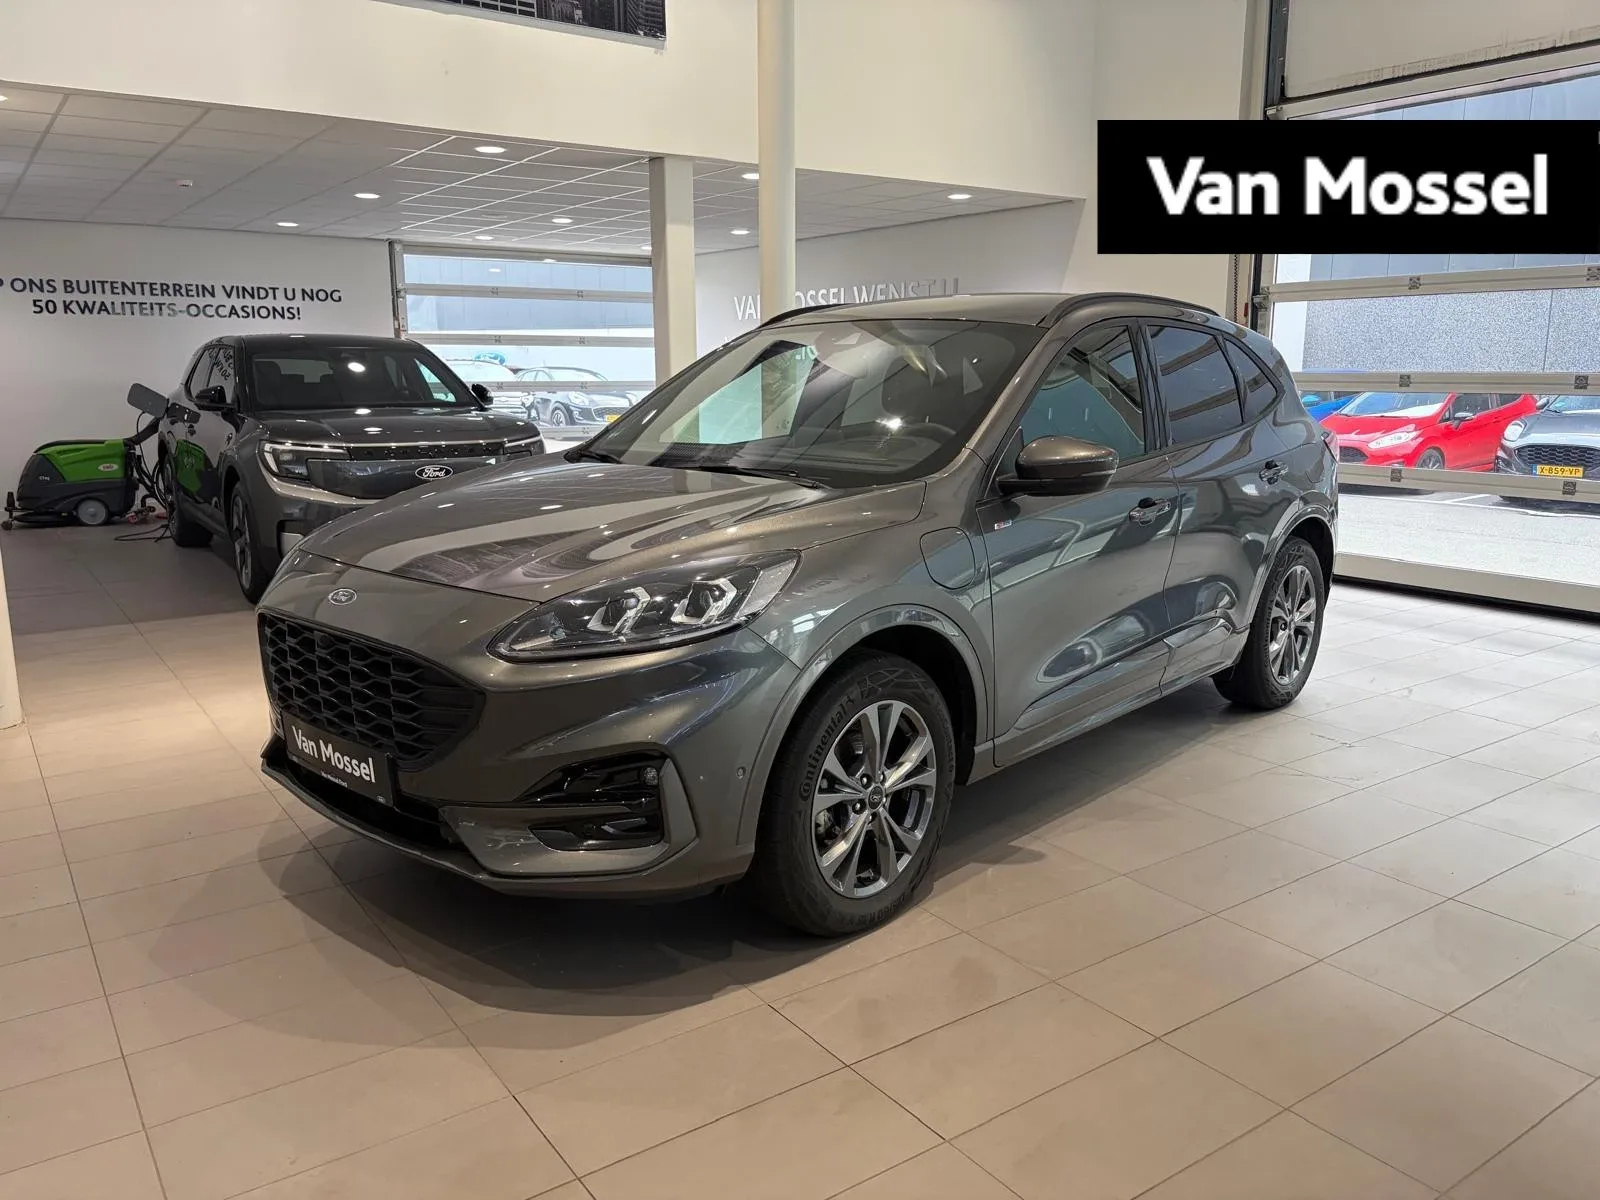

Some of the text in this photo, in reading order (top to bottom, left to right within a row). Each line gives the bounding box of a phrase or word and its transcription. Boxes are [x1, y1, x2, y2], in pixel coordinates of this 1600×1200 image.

[10, 277, 57, 294] ONS
[62, 279, 216, 299] BUITENTERREIN
[221, 285, 279, 301] VINDT
[284, 287, 296, 301] U
[301, 288, 342, 303] NOG
[794, 287, 845, 307] OSSEL
[32, 299, 301, 321] 50 KWALITEITS-OCCASIONS!
[291, 725, 319, 759] Van
[319, 739, 376, 783] Mossel
[799, 703, 848, 801] Continental
